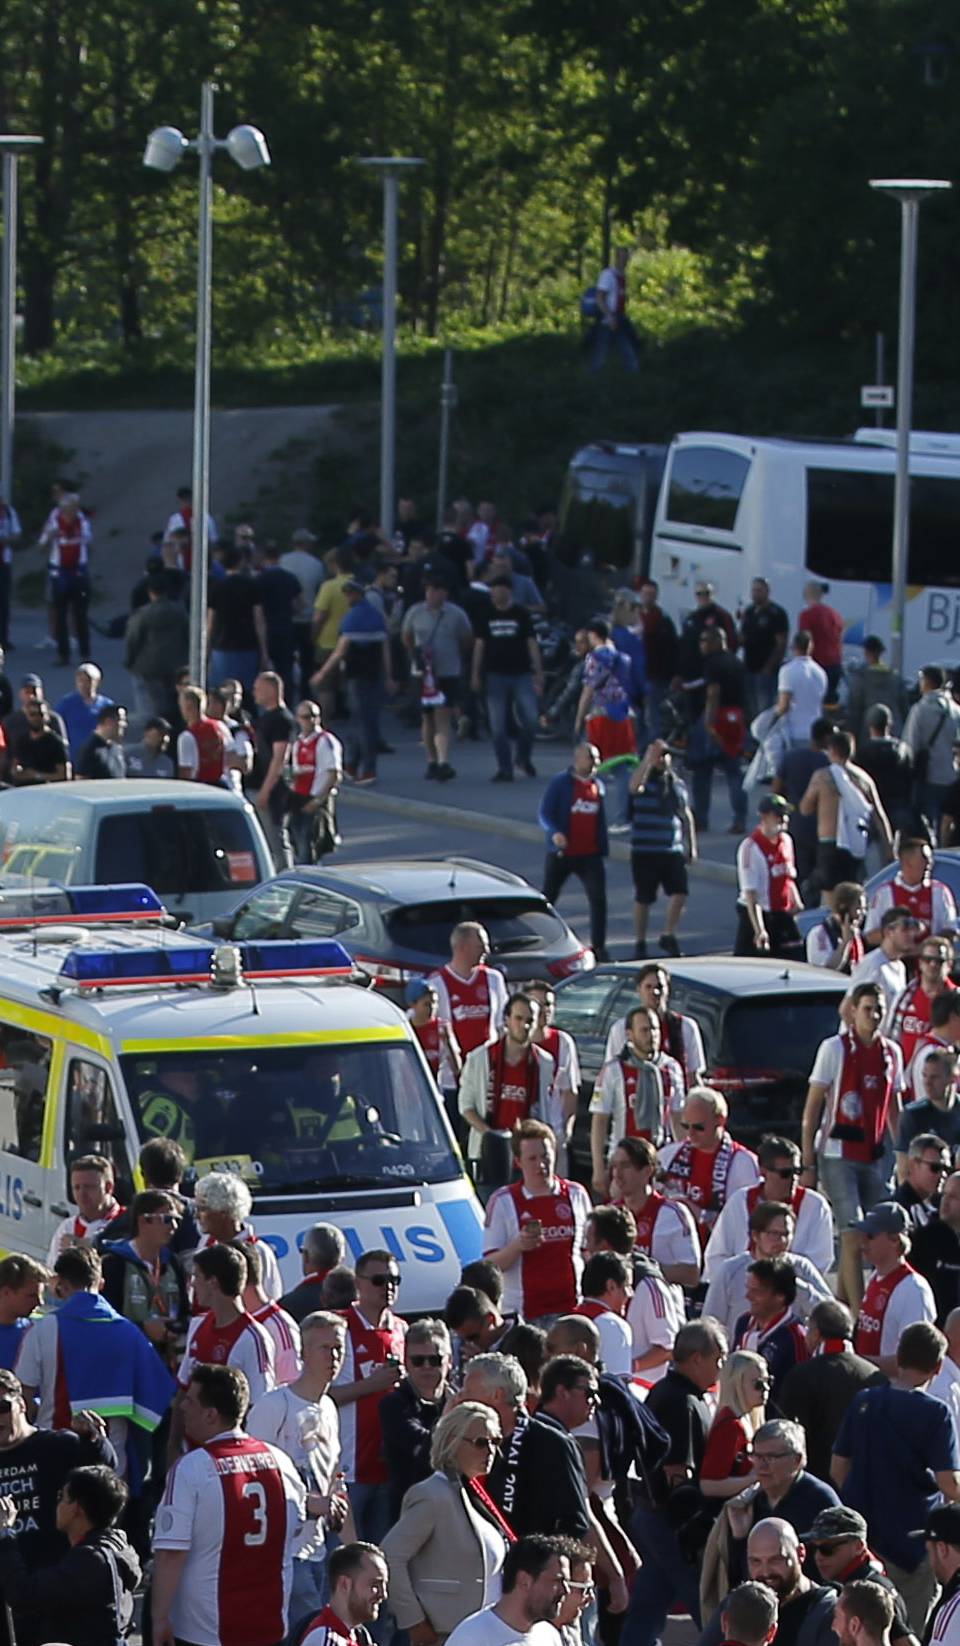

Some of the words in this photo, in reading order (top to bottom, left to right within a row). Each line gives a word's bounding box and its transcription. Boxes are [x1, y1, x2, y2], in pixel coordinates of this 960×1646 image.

[926, 592, 960, 645] Bj
[260, 1226, 446, 1265] PLIS
[541, 1225, 574, 1239] EGON
[216, 1453, 278, 1475] DERWEIRE
[243, 1481, 268, 1545] 3
